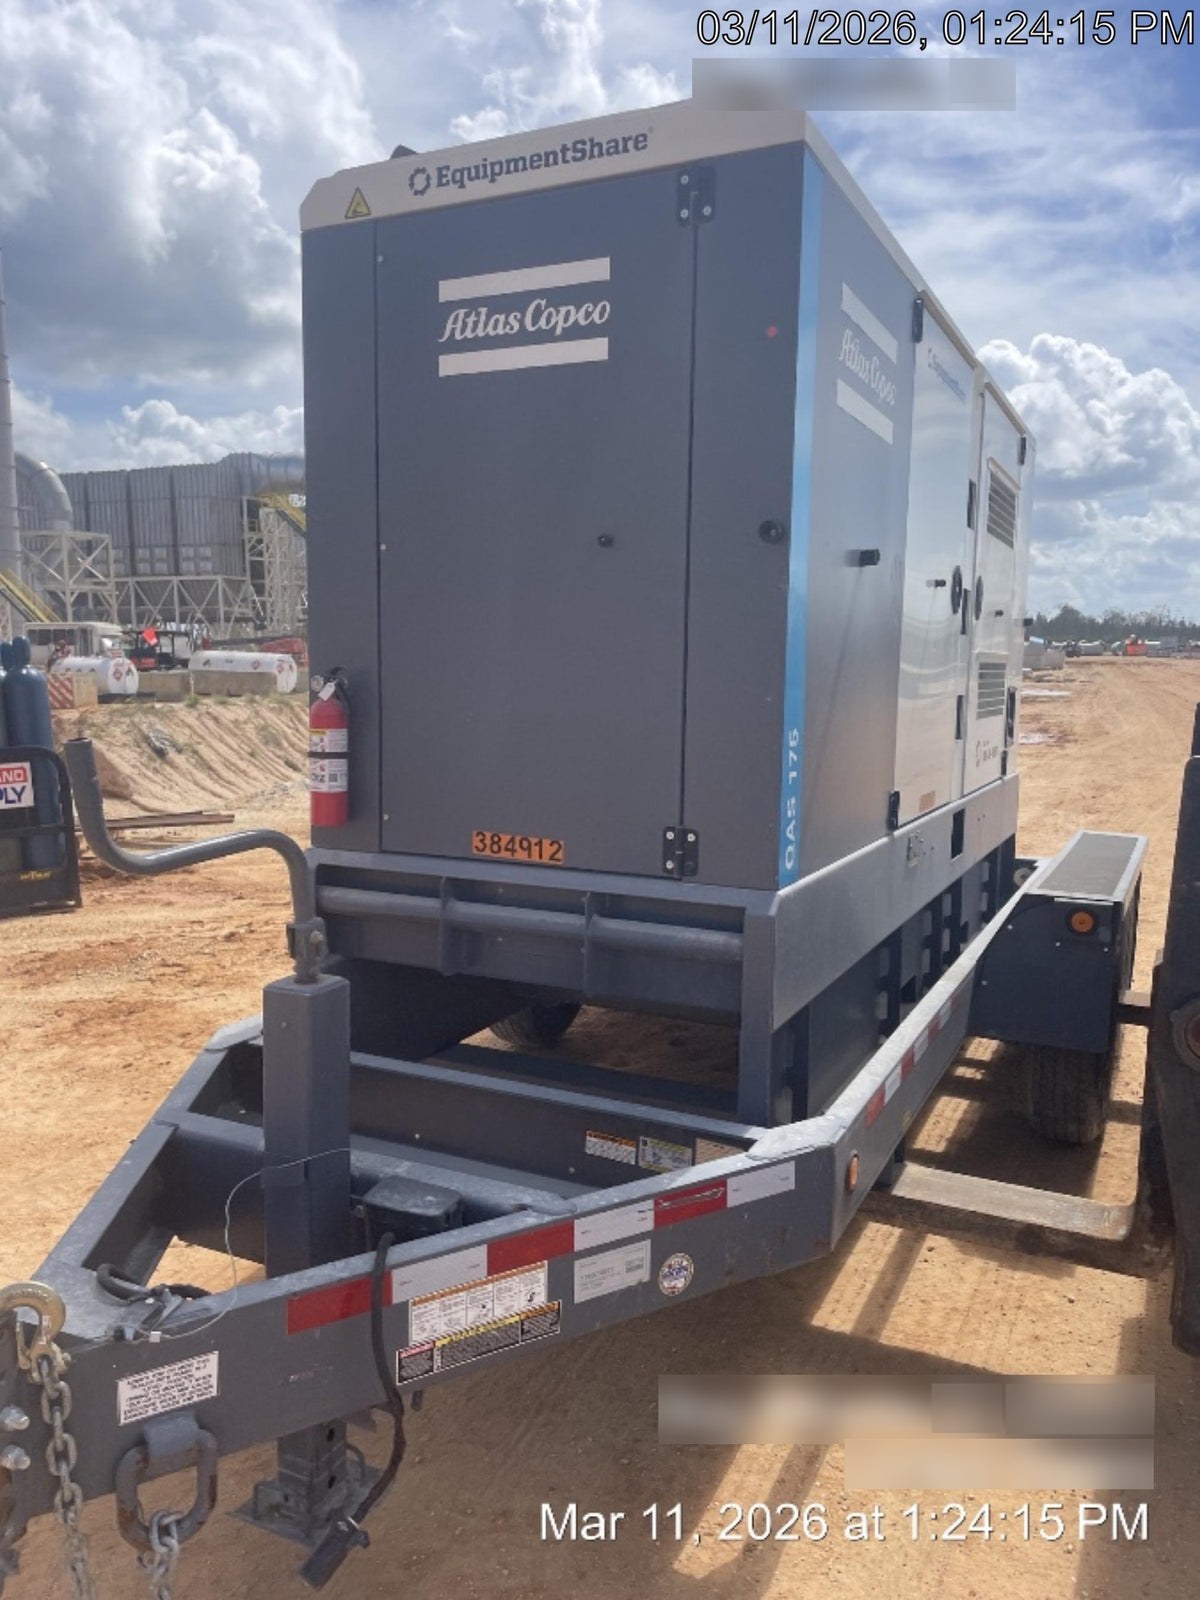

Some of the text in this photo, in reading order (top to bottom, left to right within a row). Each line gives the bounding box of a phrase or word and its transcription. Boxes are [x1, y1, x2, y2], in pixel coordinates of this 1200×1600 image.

[436, 132, 648, 189] EquipmentShare
[438, 299, 610, 343] Atlas Copco
[0, 770, 24, 783] ND
[785, 728, 799, 871] QAS 175
[474, 831, 563, 863] 384912
